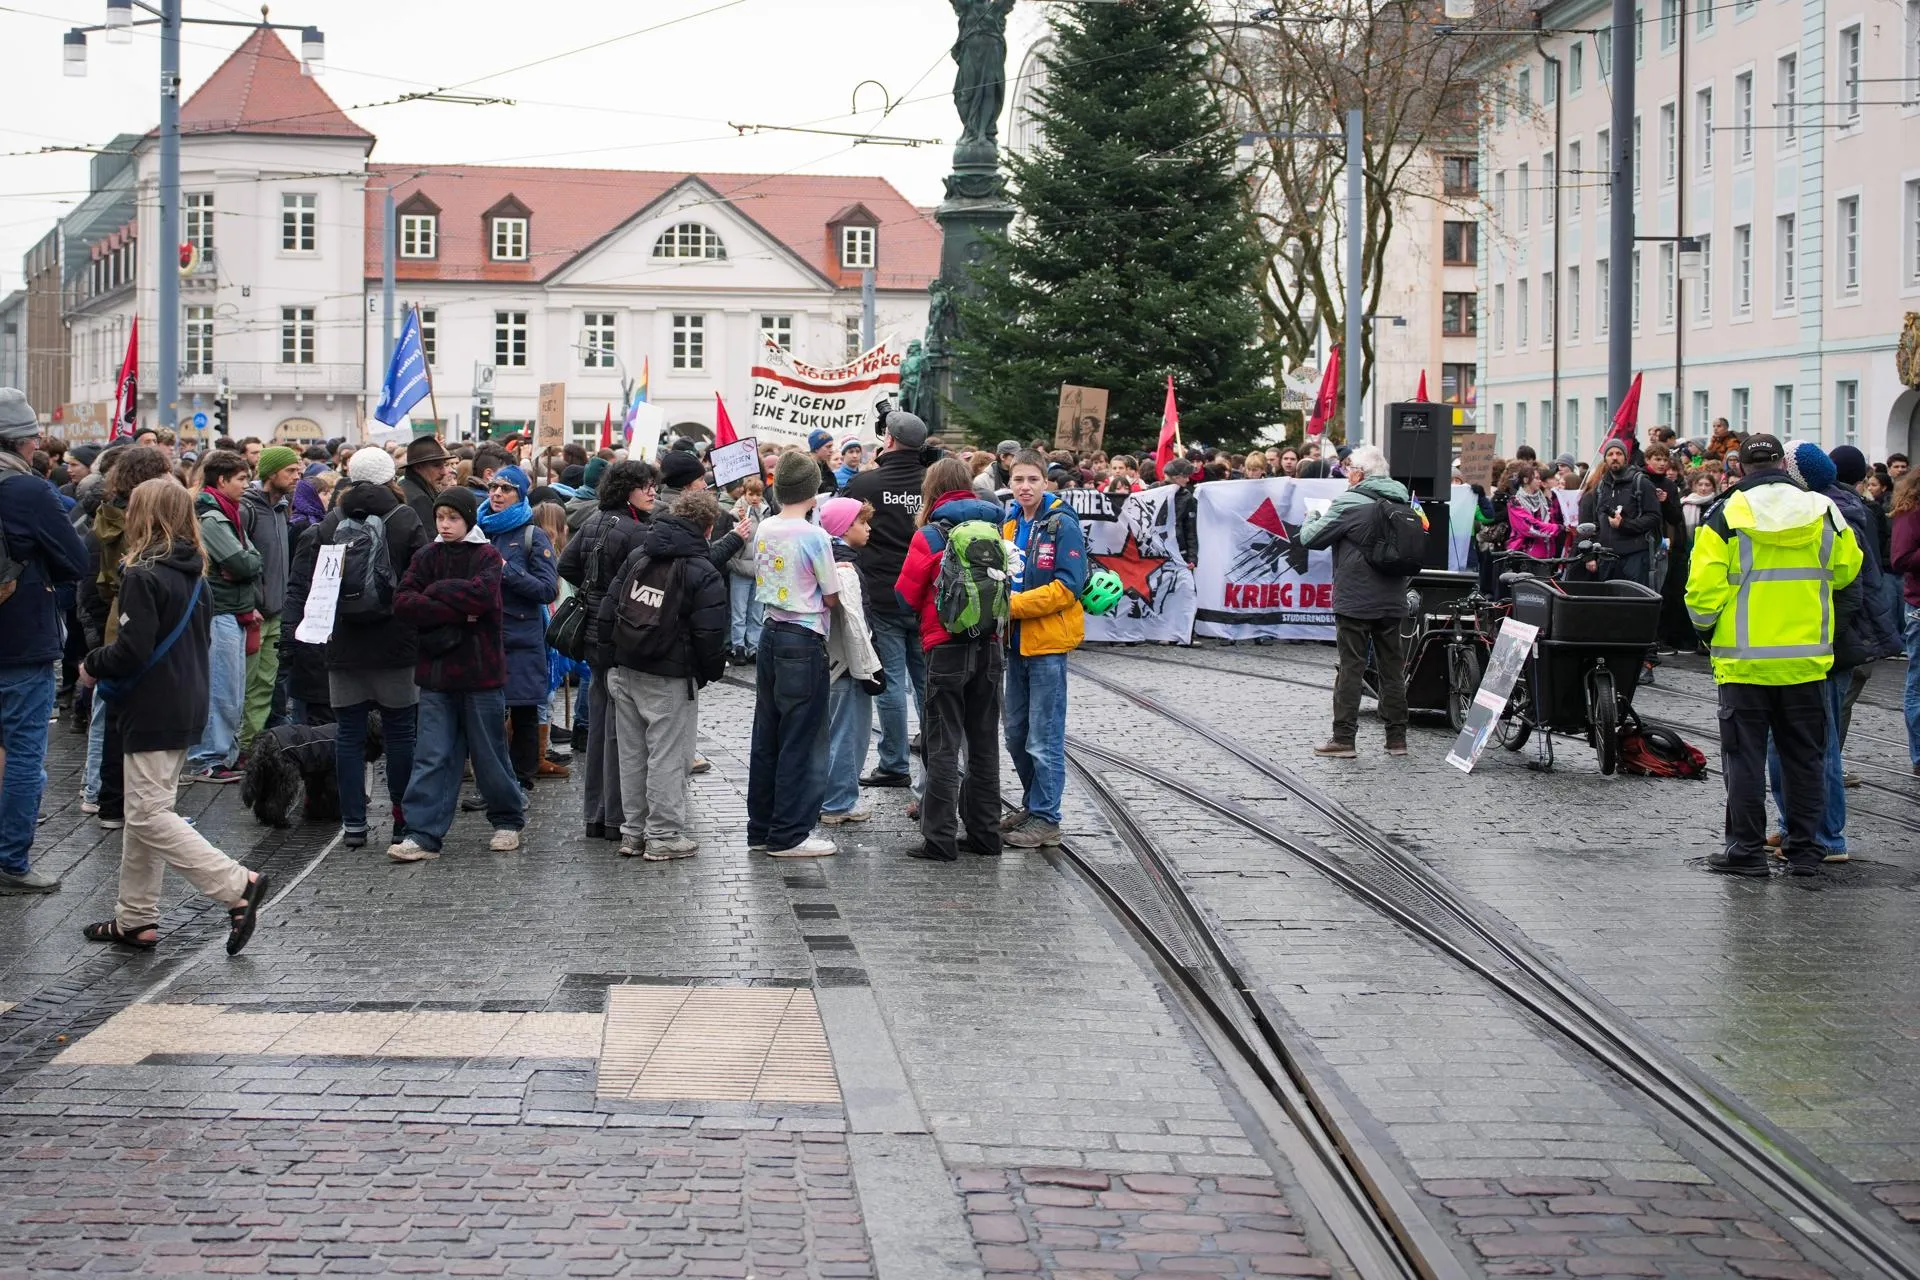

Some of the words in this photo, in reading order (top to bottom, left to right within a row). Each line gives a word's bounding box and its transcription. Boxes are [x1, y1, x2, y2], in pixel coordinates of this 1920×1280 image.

[795, 366, 858, 381] WOLLEN
[862, 354, 900, 374] KRIEG
[754, 384, 779, 400] DIE
[781, 391, 846, 411] JUGEND
[753, 403, 785, 421] EINE
[789, 411, 866, 429] ZUKUNFT!
[1747, 441, 1773, 451] POLIZEI
[882, 491, 922, 504] Baden
[630, 579, 665, 608] VAN
[1224, 582, 1293, 609] KRIEG
[1299, 583, 1335, 609] DE
